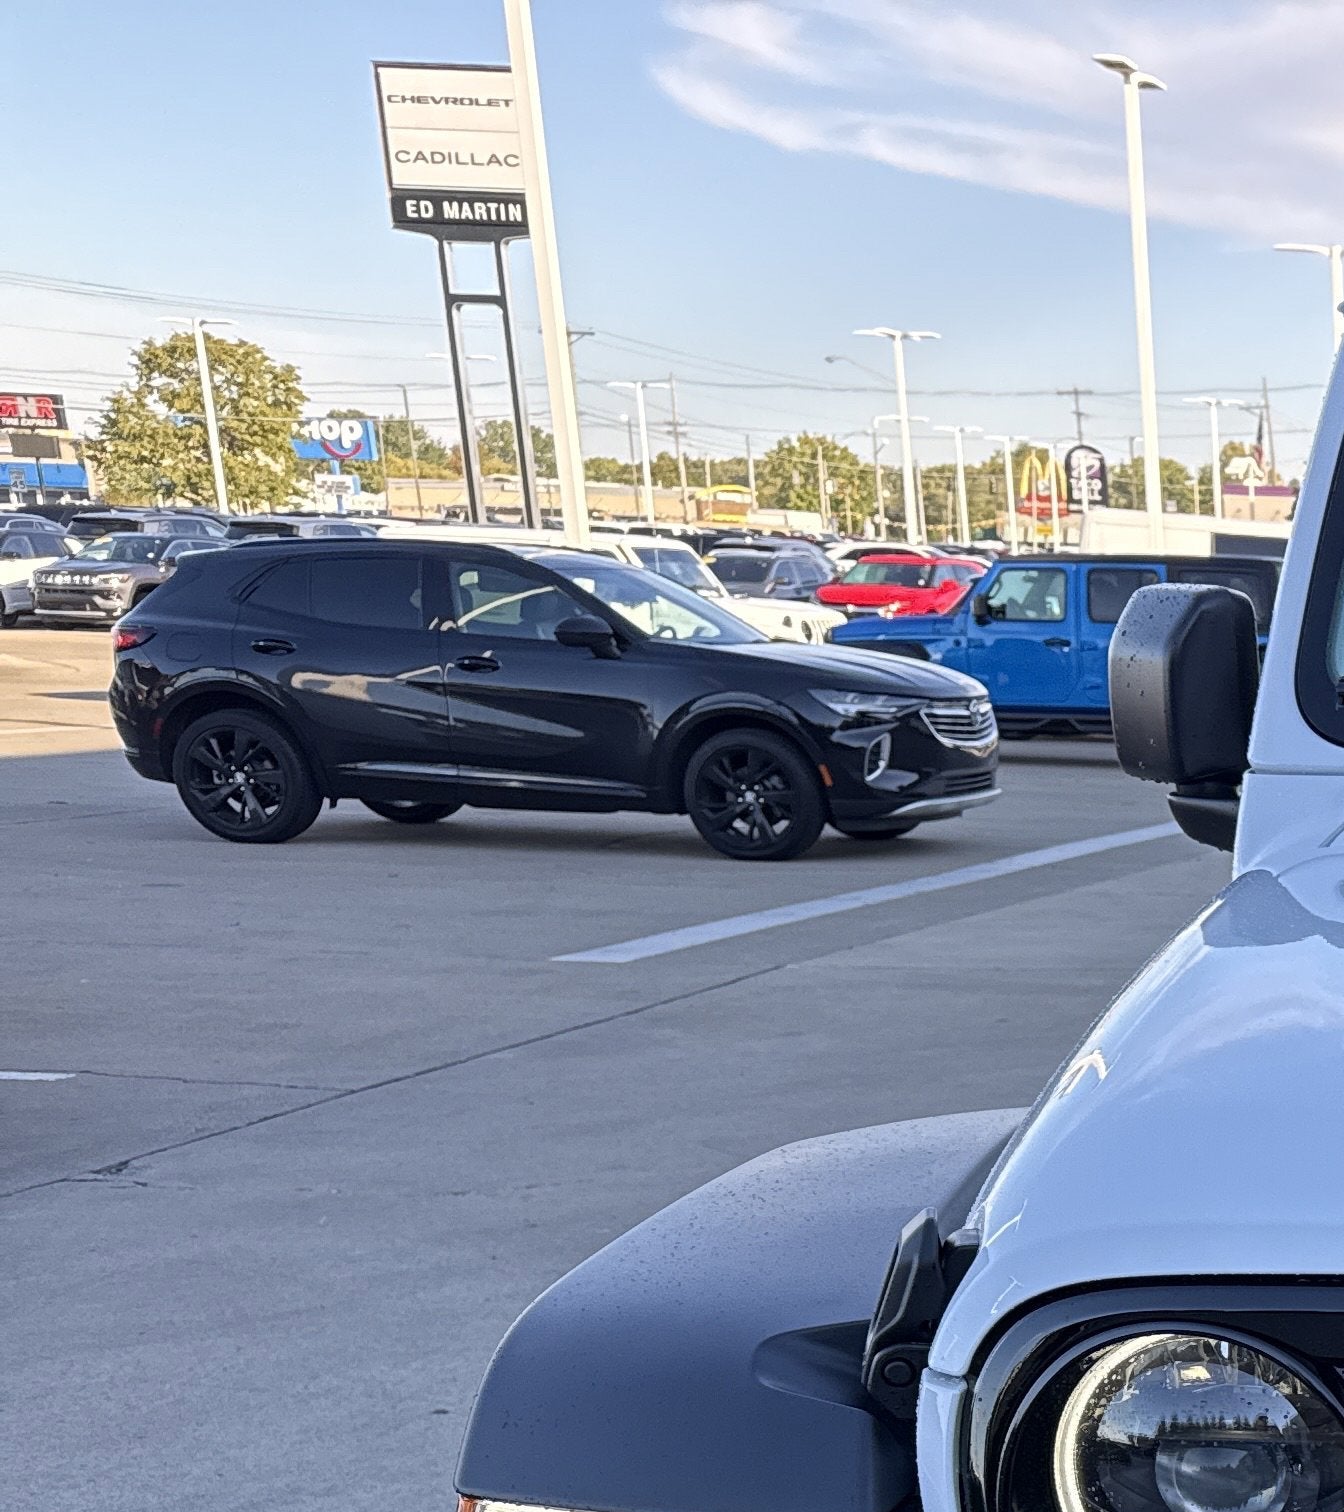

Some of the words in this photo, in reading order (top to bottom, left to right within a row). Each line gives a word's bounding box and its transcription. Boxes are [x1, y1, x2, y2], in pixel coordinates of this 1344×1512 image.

[387, 94, 514, 108] CHEVROLET
[395, 150, 521, 168] CADILLAC
[405, 199, 434, 218] ED
[442, 200, 522, 222] MARTIN
[12, 480, 26, 490] 45
